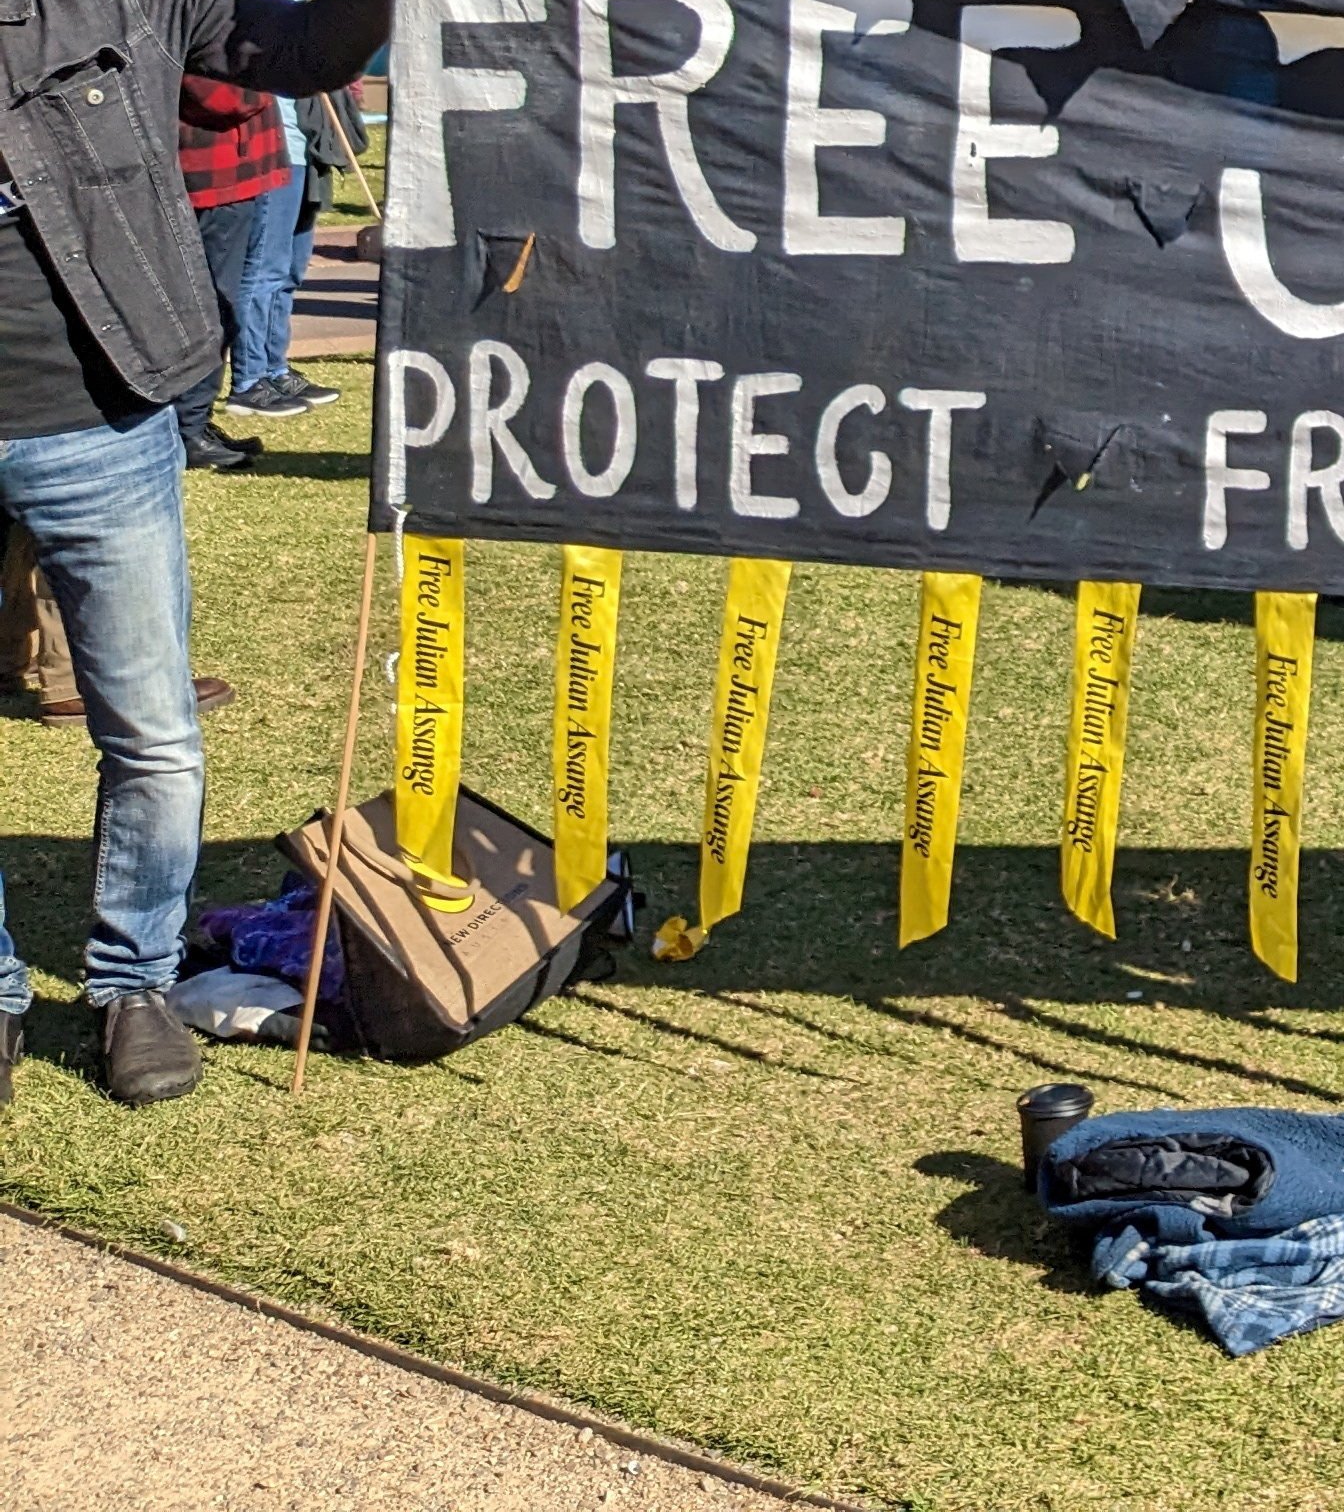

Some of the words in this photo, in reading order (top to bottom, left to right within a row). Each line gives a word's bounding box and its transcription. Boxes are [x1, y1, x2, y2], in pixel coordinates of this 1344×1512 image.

[387, 339, 987, 531] PROTECT
[418, 554, 451, 607] Free
[571, 575, 604, 629] Free
[416, 612, 449, 687] Julian
[568, 633, 600, 711] Julian
[734, 616, 767, 670] Free
[928, 614, 961, 669] Free
[1090, 609, 1126, 666] Free
[722, 675, 758, 753] Julian
[921, 673, 956, 750] Julian
[1083, 668, 1119, 745] Julian
[1265, 652, 1298, 709] Free
[403, 692, 449, 796] Assange
[559, 717, 598, 819] Assange
[1263, 711, 1294, 791] Julian
[705, 759, 747, 865] Assange
[908, 758, 949, 859] Assange
[1067, 749, 1108, 854] Assange
[1255, 795, 1291, 899] Assange
